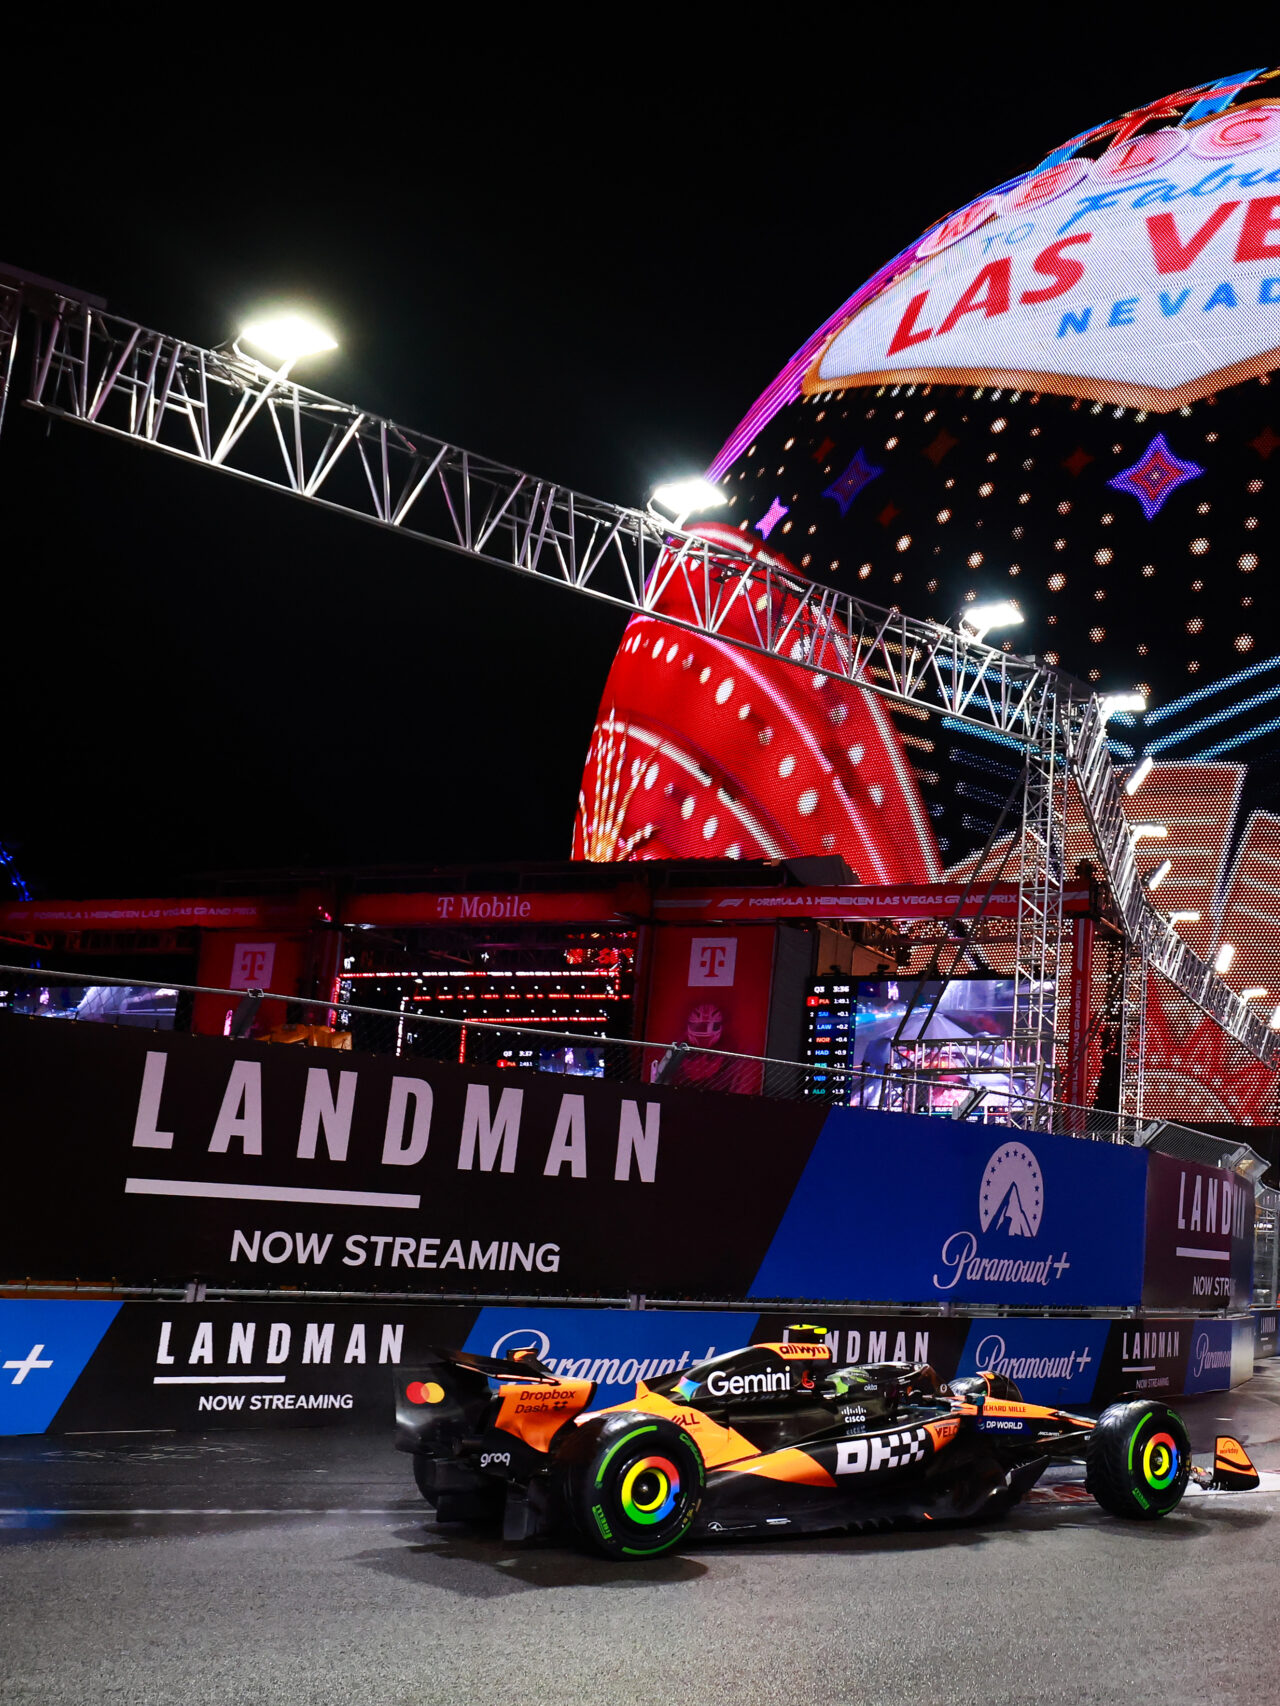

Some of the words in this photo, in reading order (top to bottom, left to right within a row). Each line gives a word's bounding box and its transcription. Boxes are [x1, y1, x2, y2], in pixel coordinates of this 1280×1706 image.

[981, 223, 1035, 254] TO
[886, 232, 1093, 357] LAS
[460, 896, 531, 918] Mobile
[750, 897, 804, 907] FORMULA
[815, 897, 874, 905] HEINEKEN
[876, 896, 900, 905] LAS
[902, 896, 942, 905] VEGAS
[988, 894, 1017, 903] PRIX
[133, 1051, 661, 1183] LANDMAN
[230, 1230, 333, 1267] NOW
[343, 1234, 560, 1273] STREAMING
[933, 1231, 1070, 1289] Paramount+
[1193, 1276, 1214, 1296] NOW
[156, 1321, 404, 1364] LANDMAN
[779, 1345, 826, 1357] allwyn
[1122, 1332, 1180, 1359] LANDMAN
[707, 1365, 791, 1396] Gemini
[198, 1395, 245, 1411] NOW
[250, 1393, 353, 1411] STREAMING
[520, 1390, 576, 1402] Dropbox
[515, 1403, 548, 1414] Dash
[997, 1421, 1023, 1429] WORLD
[480, 1453, 511, 1467] groq
